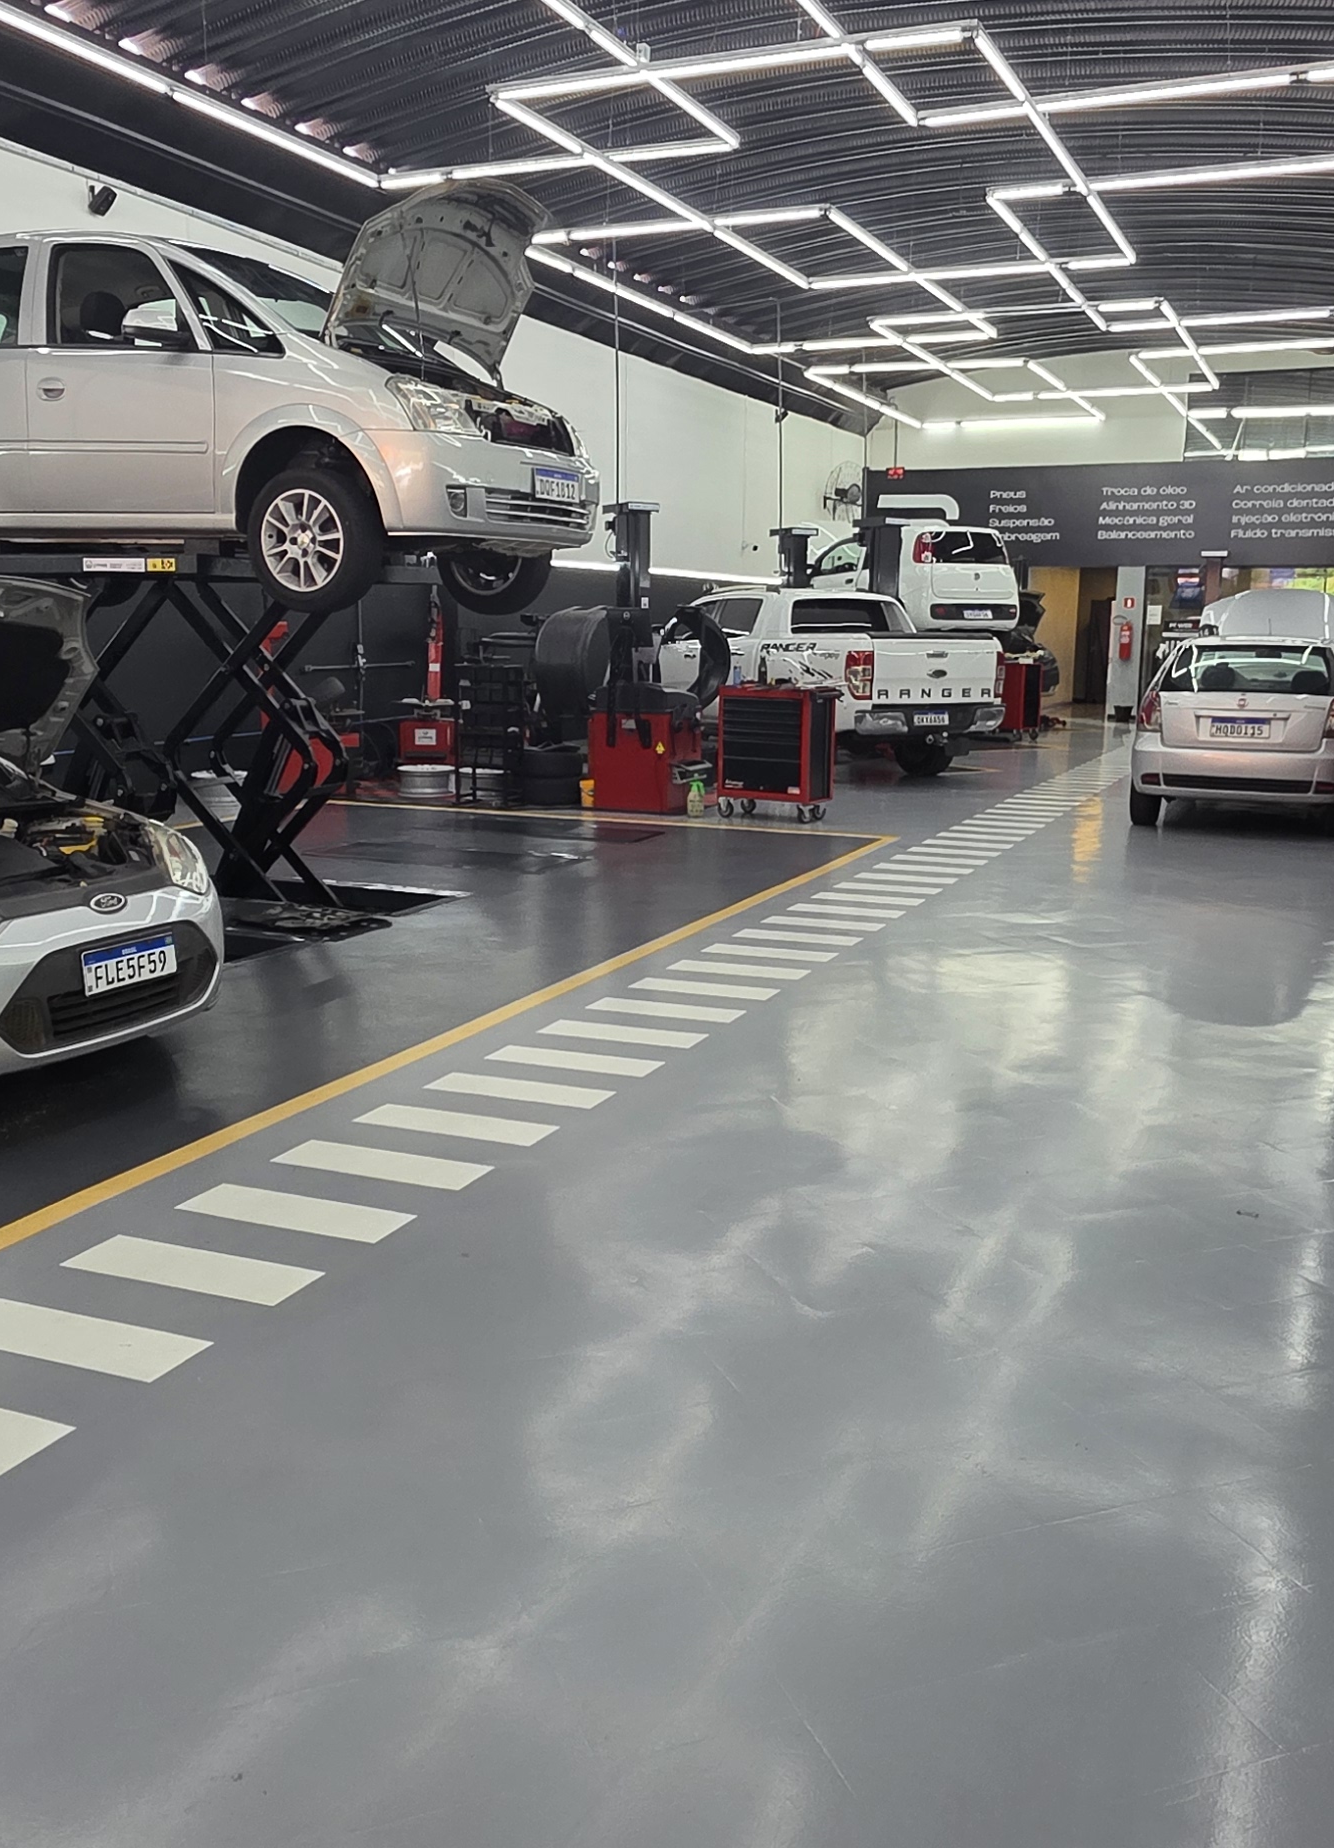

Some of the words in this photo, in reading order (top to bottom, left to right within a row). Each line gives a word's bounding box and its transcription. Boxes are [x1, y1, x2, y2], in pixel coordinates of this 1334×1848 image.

[1101, 487, 1138, 496] Troca
[1141, 485, 1157, 495] de
[1233, 484, 1251, 493] Ar
[990, 490, 1026, 499] Pneus
[989, 503, 1027, 514] Freios
[1100, 500, 1177, 511] Alinhamento
[1179, 500, 1196, 509] 3D
[1232, 498, 1284, 509] Correia
[988, 517, 1055, 528] Suspensão
[1098, 514, 1157, 526] Mecânica
[1159, 514, 1194, 527] geral
[1232, 513, 1279, 526] Injeção
[998, 531, 1060, 543] mbreagem
[1097, 529, 1195, 540] Balanceamento
[1231, 529, 1268, 539] Fluido
[760, 642, 817, 653] RANGER
[877, 687, 991, 699] RANGER
[94, 950, 167, 989] FLE5F59
